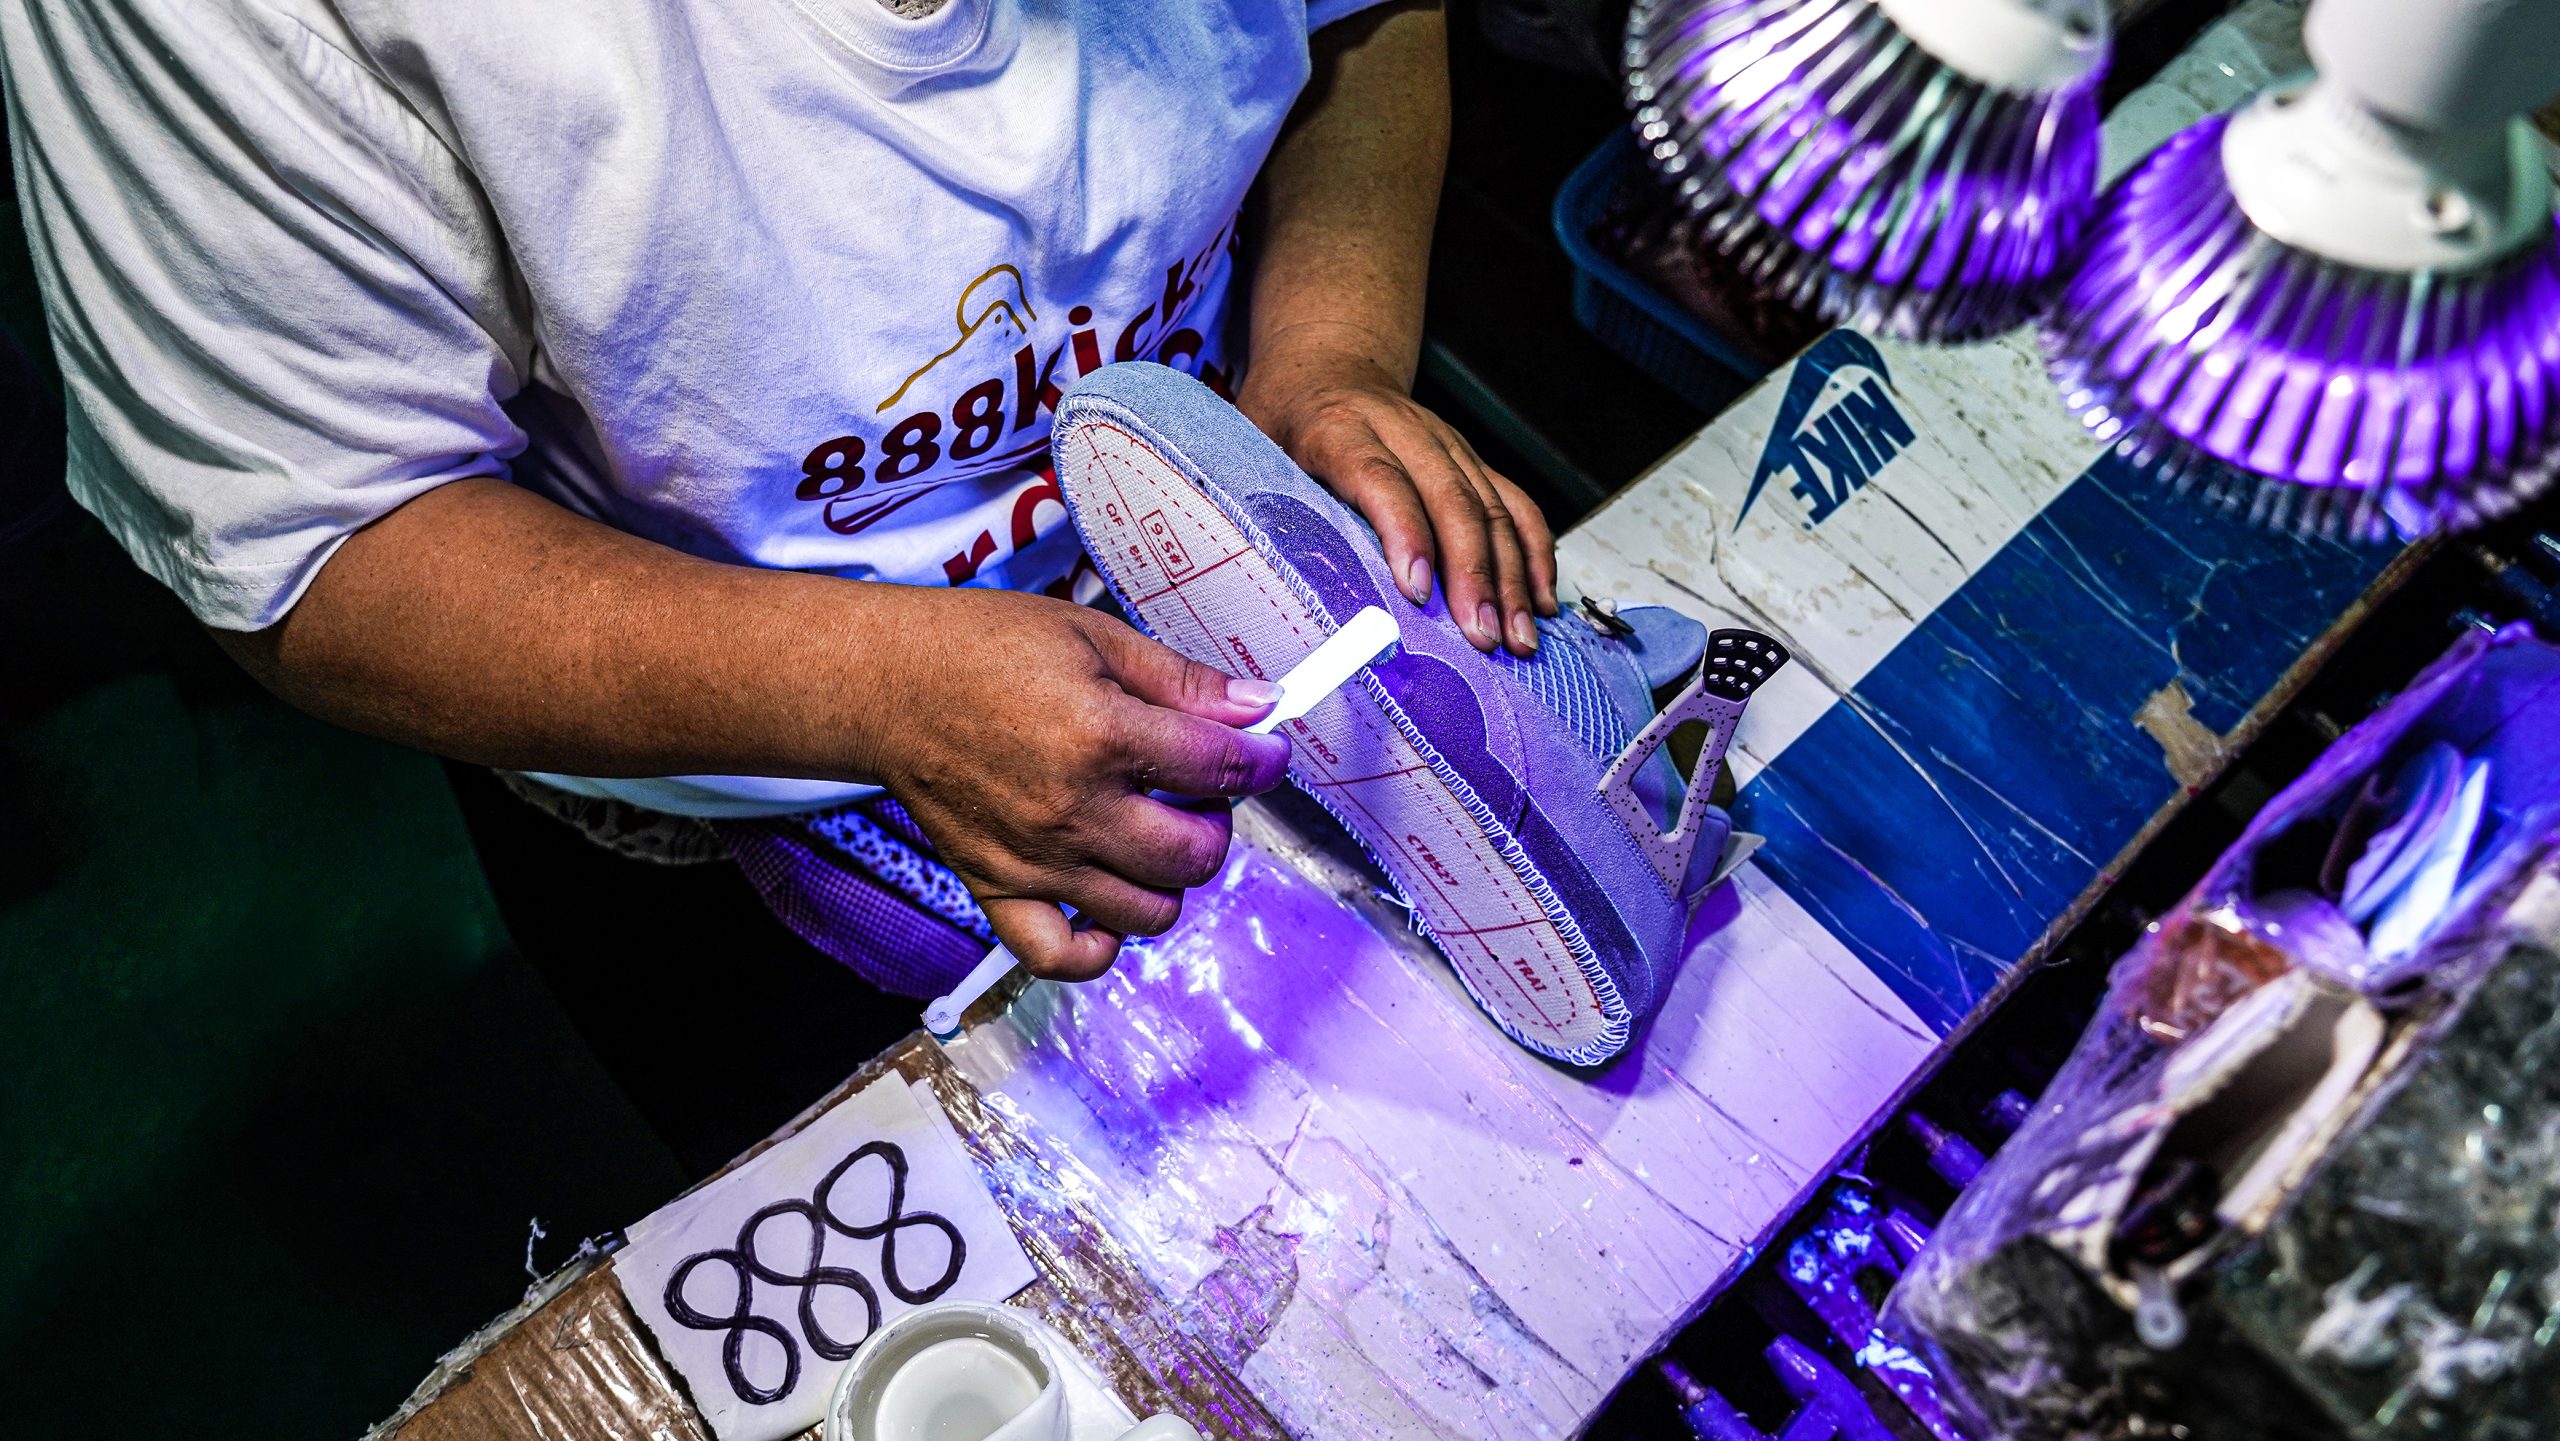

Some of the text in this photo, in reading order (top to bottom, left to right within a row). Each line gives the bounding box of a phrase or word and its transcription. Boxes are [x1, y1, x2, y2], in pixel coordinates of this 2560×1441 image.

[1772, 376, 1917, 525] NIKE
[1226, 635, 1264, 680] JORD
[663, 1140, 967, 1405] 888
